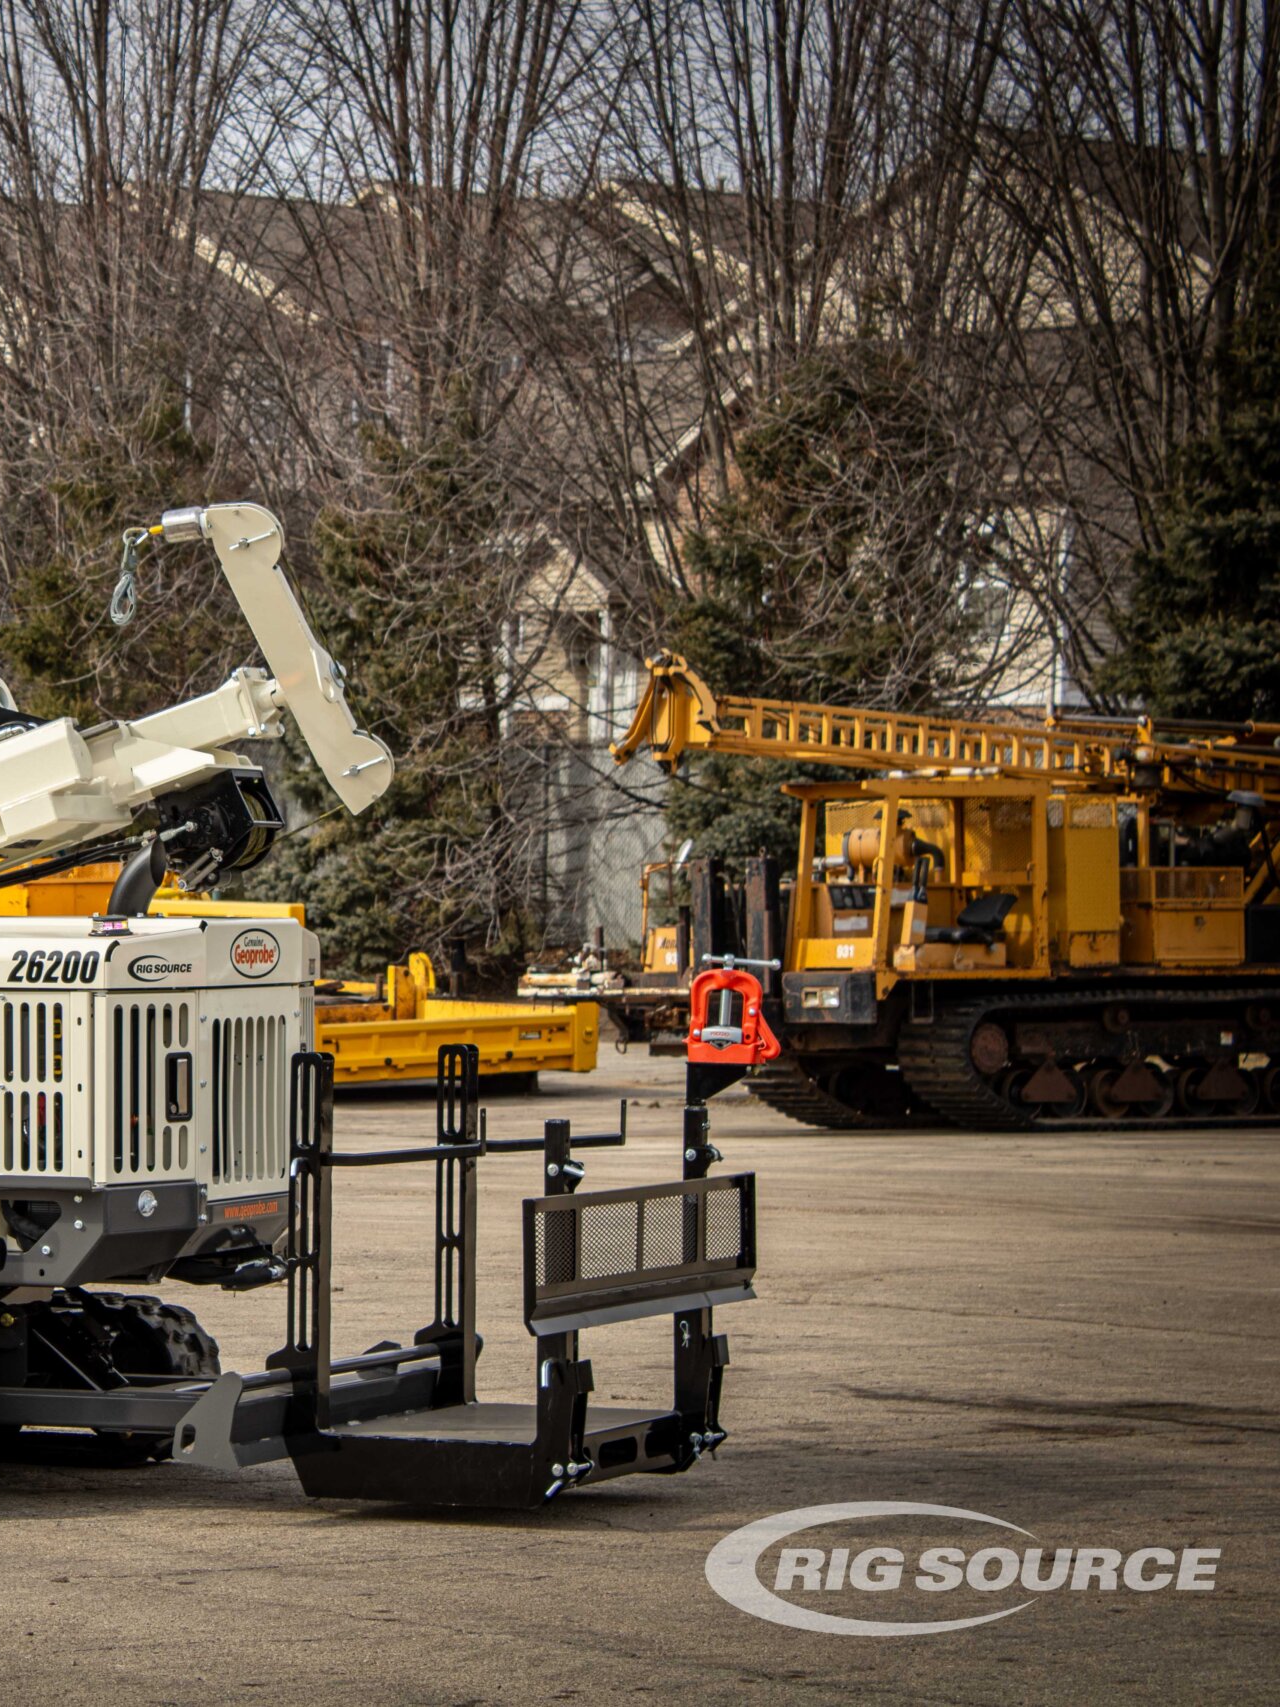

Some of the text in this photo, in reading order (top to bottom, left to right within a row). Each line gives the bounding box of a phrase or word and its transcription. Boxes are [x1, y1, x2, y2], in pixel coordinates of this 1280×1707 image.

[243, 936, 264, 947] Genuine
[7, 949, 100, 984] 26200
[136, 963, 193, 974] RIG SOURCE
[223, 1200, 278, 1221] www.geoprobe.com
